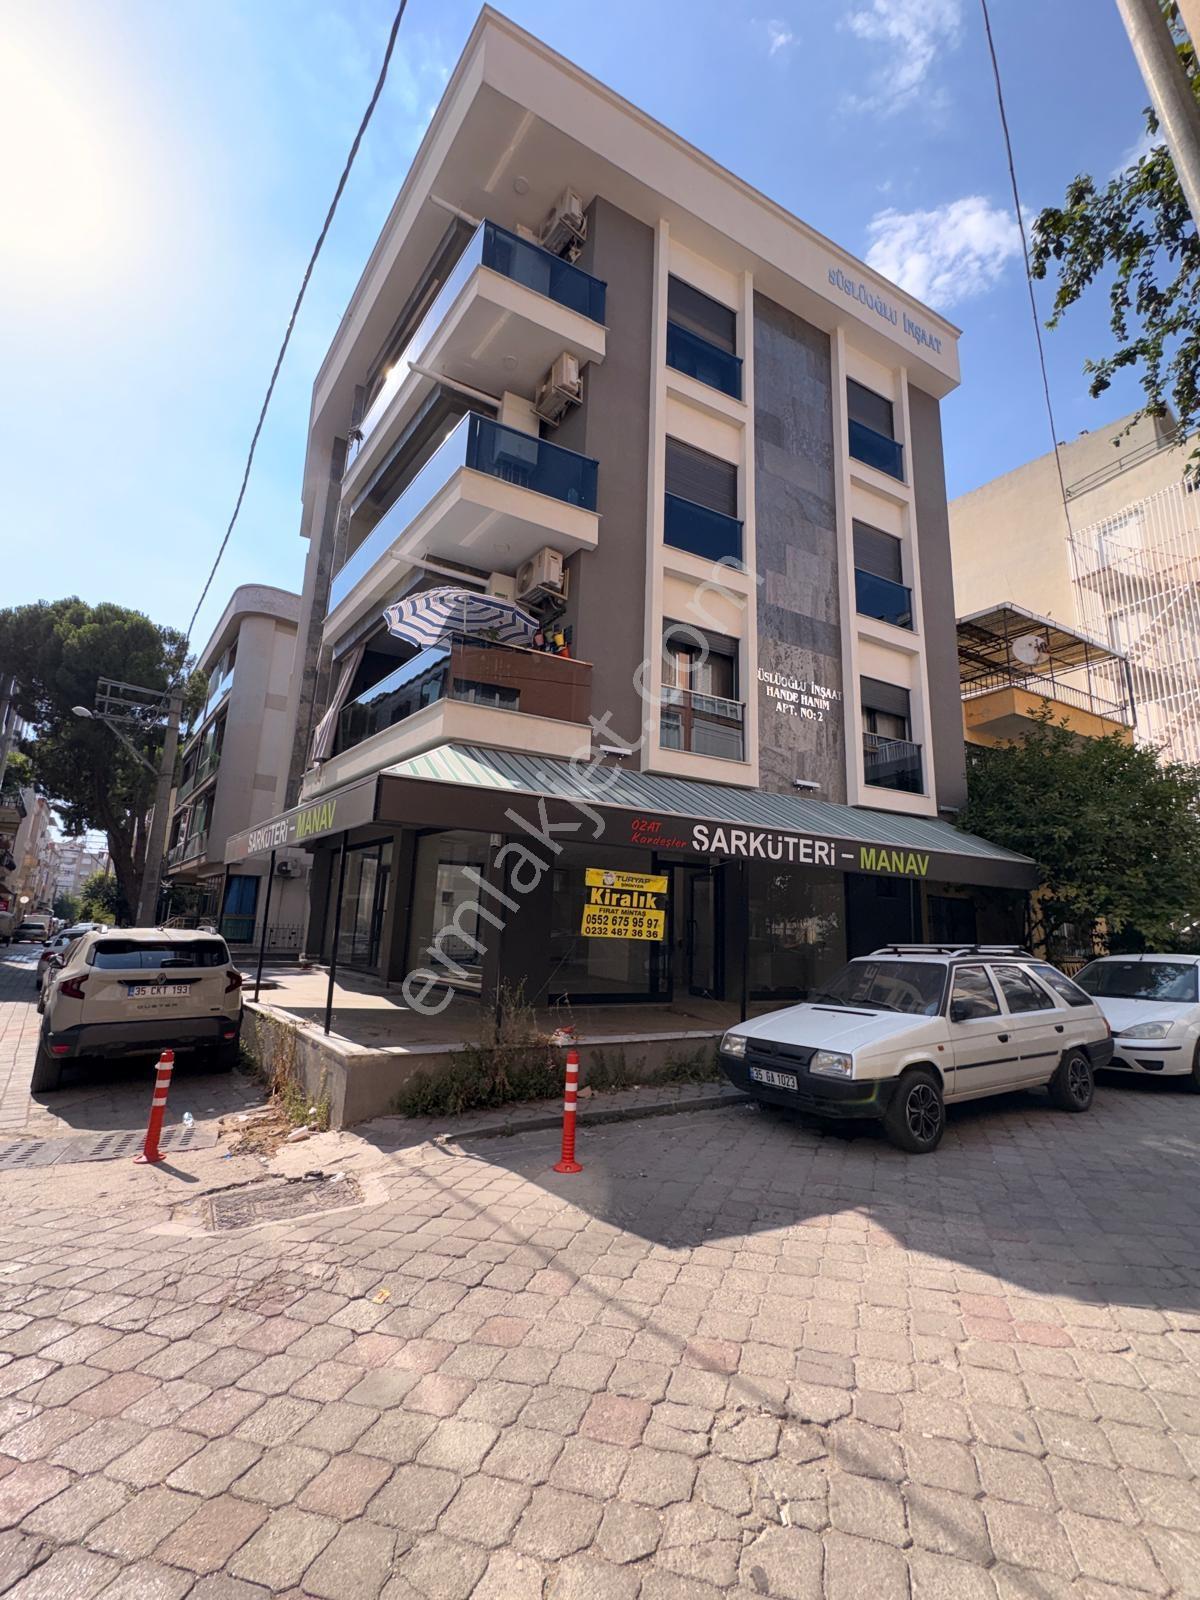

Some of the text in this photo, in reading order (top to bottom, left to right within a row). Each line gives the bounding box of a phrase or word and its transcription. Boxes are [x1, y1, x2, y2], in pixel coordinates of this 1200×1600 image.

[757, 668, 806, 692] ÜSLÜOĞLU
[766, 685, 830, 711] HANDE HANIM
[776, 701, 824, 721] APT. NO:2
[296, 799, 337, 838] MANAV
[860, 846, 930, 876] MANAV
[590, 887, 657, 909] Kiralık
[586, 914, 659, 929] 0552 675 95 97
[585, 926, 658, 939] 0232 487 36 36
[134, 985, 188, 996] 35 CKT 193
[753, 1068, 763, 1080] 35
[777, 1074, 796, 1088] 1023
